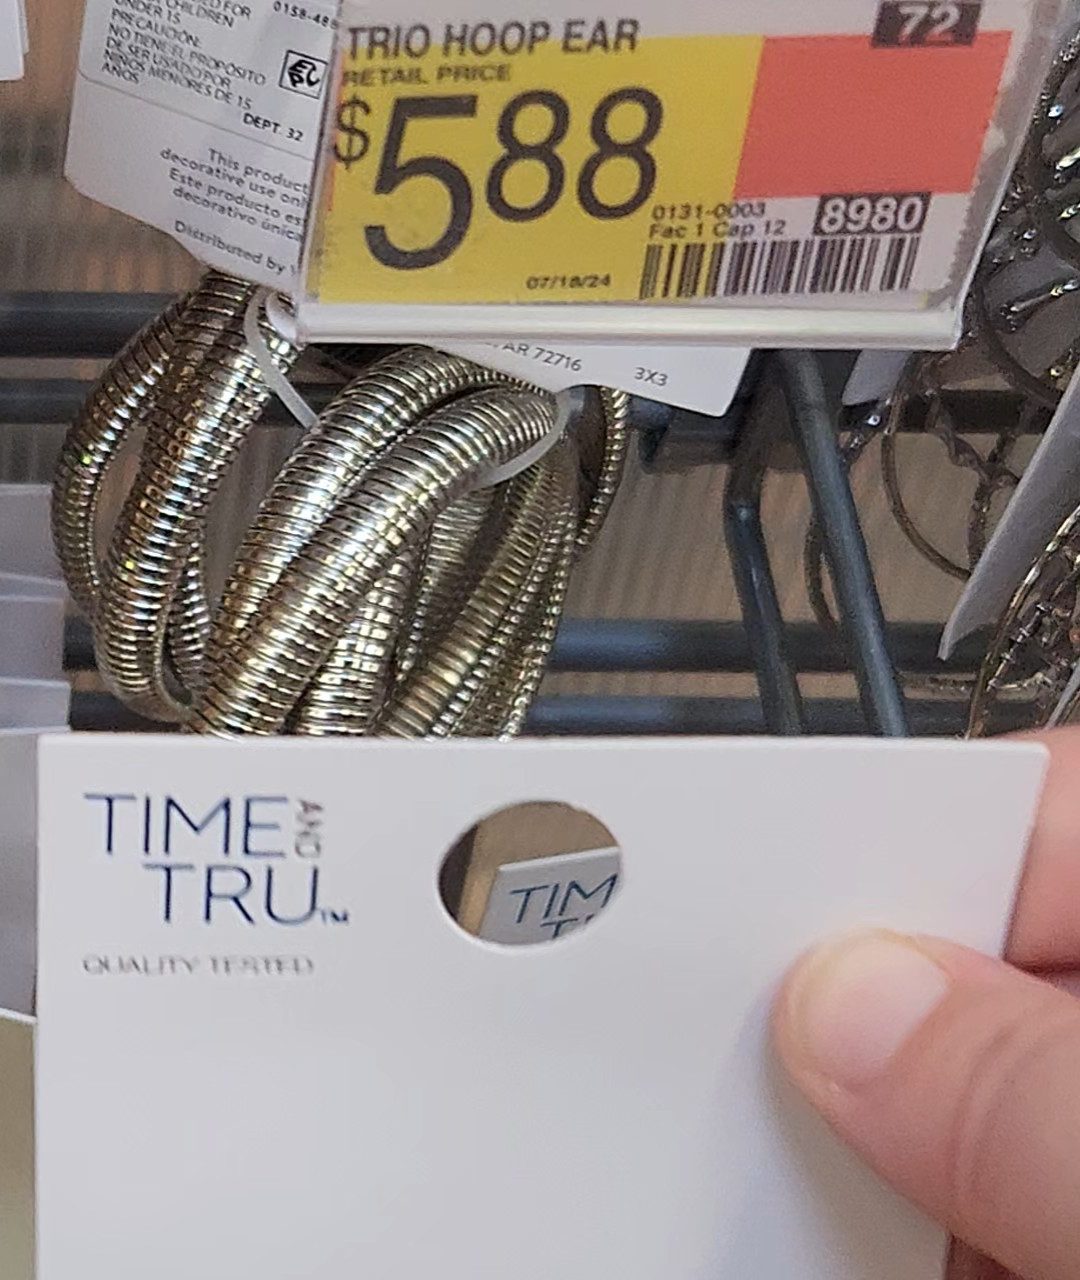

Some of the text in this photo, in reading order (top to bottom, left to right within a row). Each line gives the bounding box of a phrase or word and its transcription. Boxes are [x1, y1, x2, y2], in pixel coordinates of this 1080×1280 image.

[165, 9, 182, 25] 15
[222, 0, 252, 19] FOR
[898, 4, 961, 42] 72
[107, 23, 131, 40] NO
[131, 31, 167, 52] TIENE
[170, 44, 186, 59] EL
[349, 19, 638, 60] TRIO HOOP EAR
[105, 35, 232, 89] DE SER USADO POR
[341, 64, 512, 86] RETAIL PRICE
[146, 65, 213, 96] MENORES
[213, 87, 233, 104] DE
[236, 95, 252, 110] 15
[243, 111, 304, 143] DEPT. 32
[160, 148, 276, 199] decorative use
[209, 148, 308, 195] This product
[169, 168, 280, 217] Este producto
[173, 186, 255, 225] decorativo
[652, 203, 766, 220] 0131-0003
[821, 197, 922, 233] 8980
[174, 220, 286, 276] Distributed by
[649, 220, 786, 241] Fac 1 Cap 12
[526, 274, 611, 291] 07/18/24
[503, 342, 582, 372] AR 72716
[634, 367, 669, 387] 3X3
[84, 793, 288, 858] TIME
[142, 863, 318, 924] TRU
[83, 954, 314, 975] QUALITY TESTED
